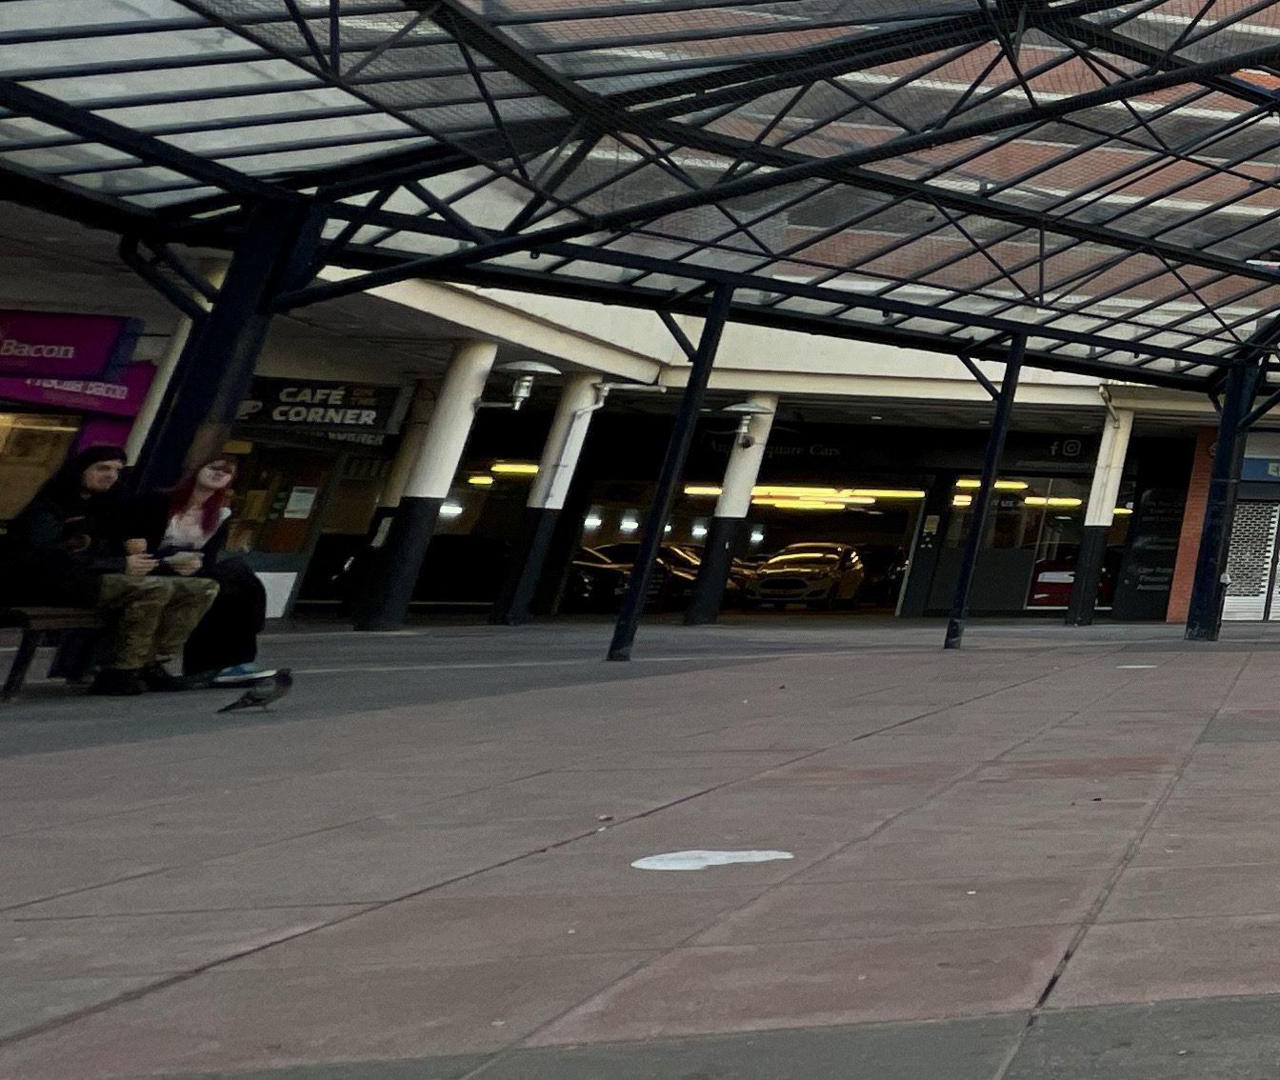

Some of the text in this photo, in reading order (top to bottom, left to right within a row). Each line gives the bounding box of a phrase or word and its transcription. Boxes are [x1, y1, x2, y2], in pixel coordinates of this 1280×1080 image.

[0, 339, 75, 358] Bacon
[279, 386, 346, 405] CAFÉ
[271, 405, 377, 425] CORNER
